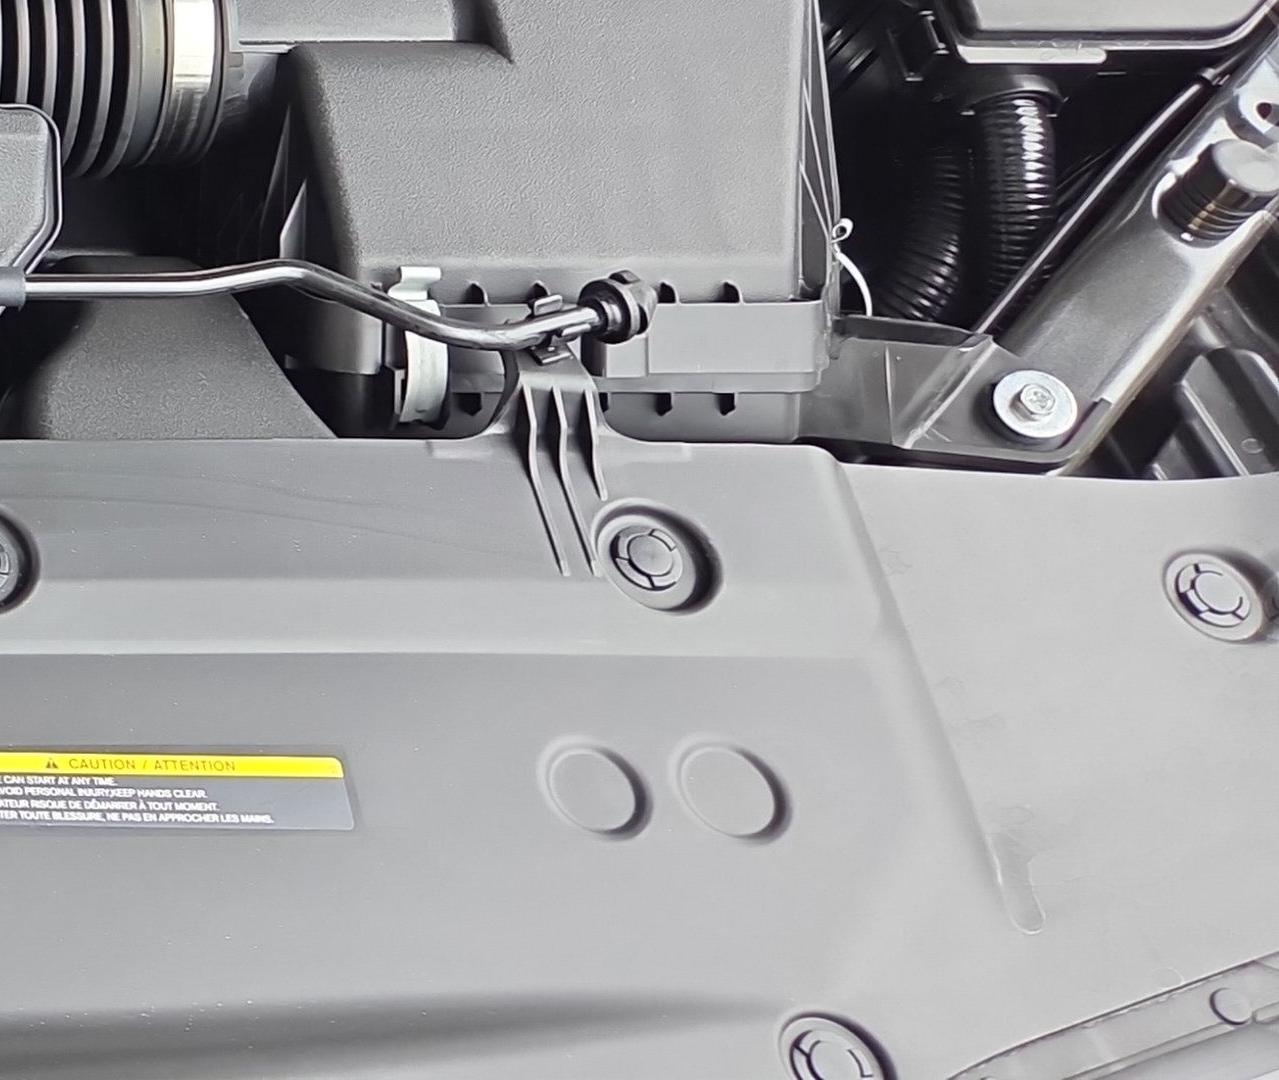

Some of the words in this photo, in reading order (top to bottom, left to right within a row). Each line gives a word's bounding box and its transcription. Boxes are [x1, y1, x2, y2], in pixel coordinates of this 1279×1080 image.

[68, 759, 136, 770] CAUTION
[154, 759, 237, 772] ATTENTION
[3, 776, 27, 785] CAN
[27, 776, 57, 786] START
[57, 777, 70, 785] AT
[71, 777, 91, 786] ANY
[24, 787, 77, 797] PERSONAL
[137, 789, 172, 799] HANDS
[30, 799, 66, 810] RISQUE
[68, 800, 84, 809] DE
[85, 798, 138, 811] DÉMARRER
[138, 798, 148, 811] À
[148, 801, 173, 811] TOUT
[19, 810, 51, 820] TOUTE
[107, 812, 123, 821] NE
[123, 812, 142, 822] PAS
[142, 813, 157, 822] EN
[158, 813, 220, 823] APPROCHER
[221, 814, 239, 823] LES
